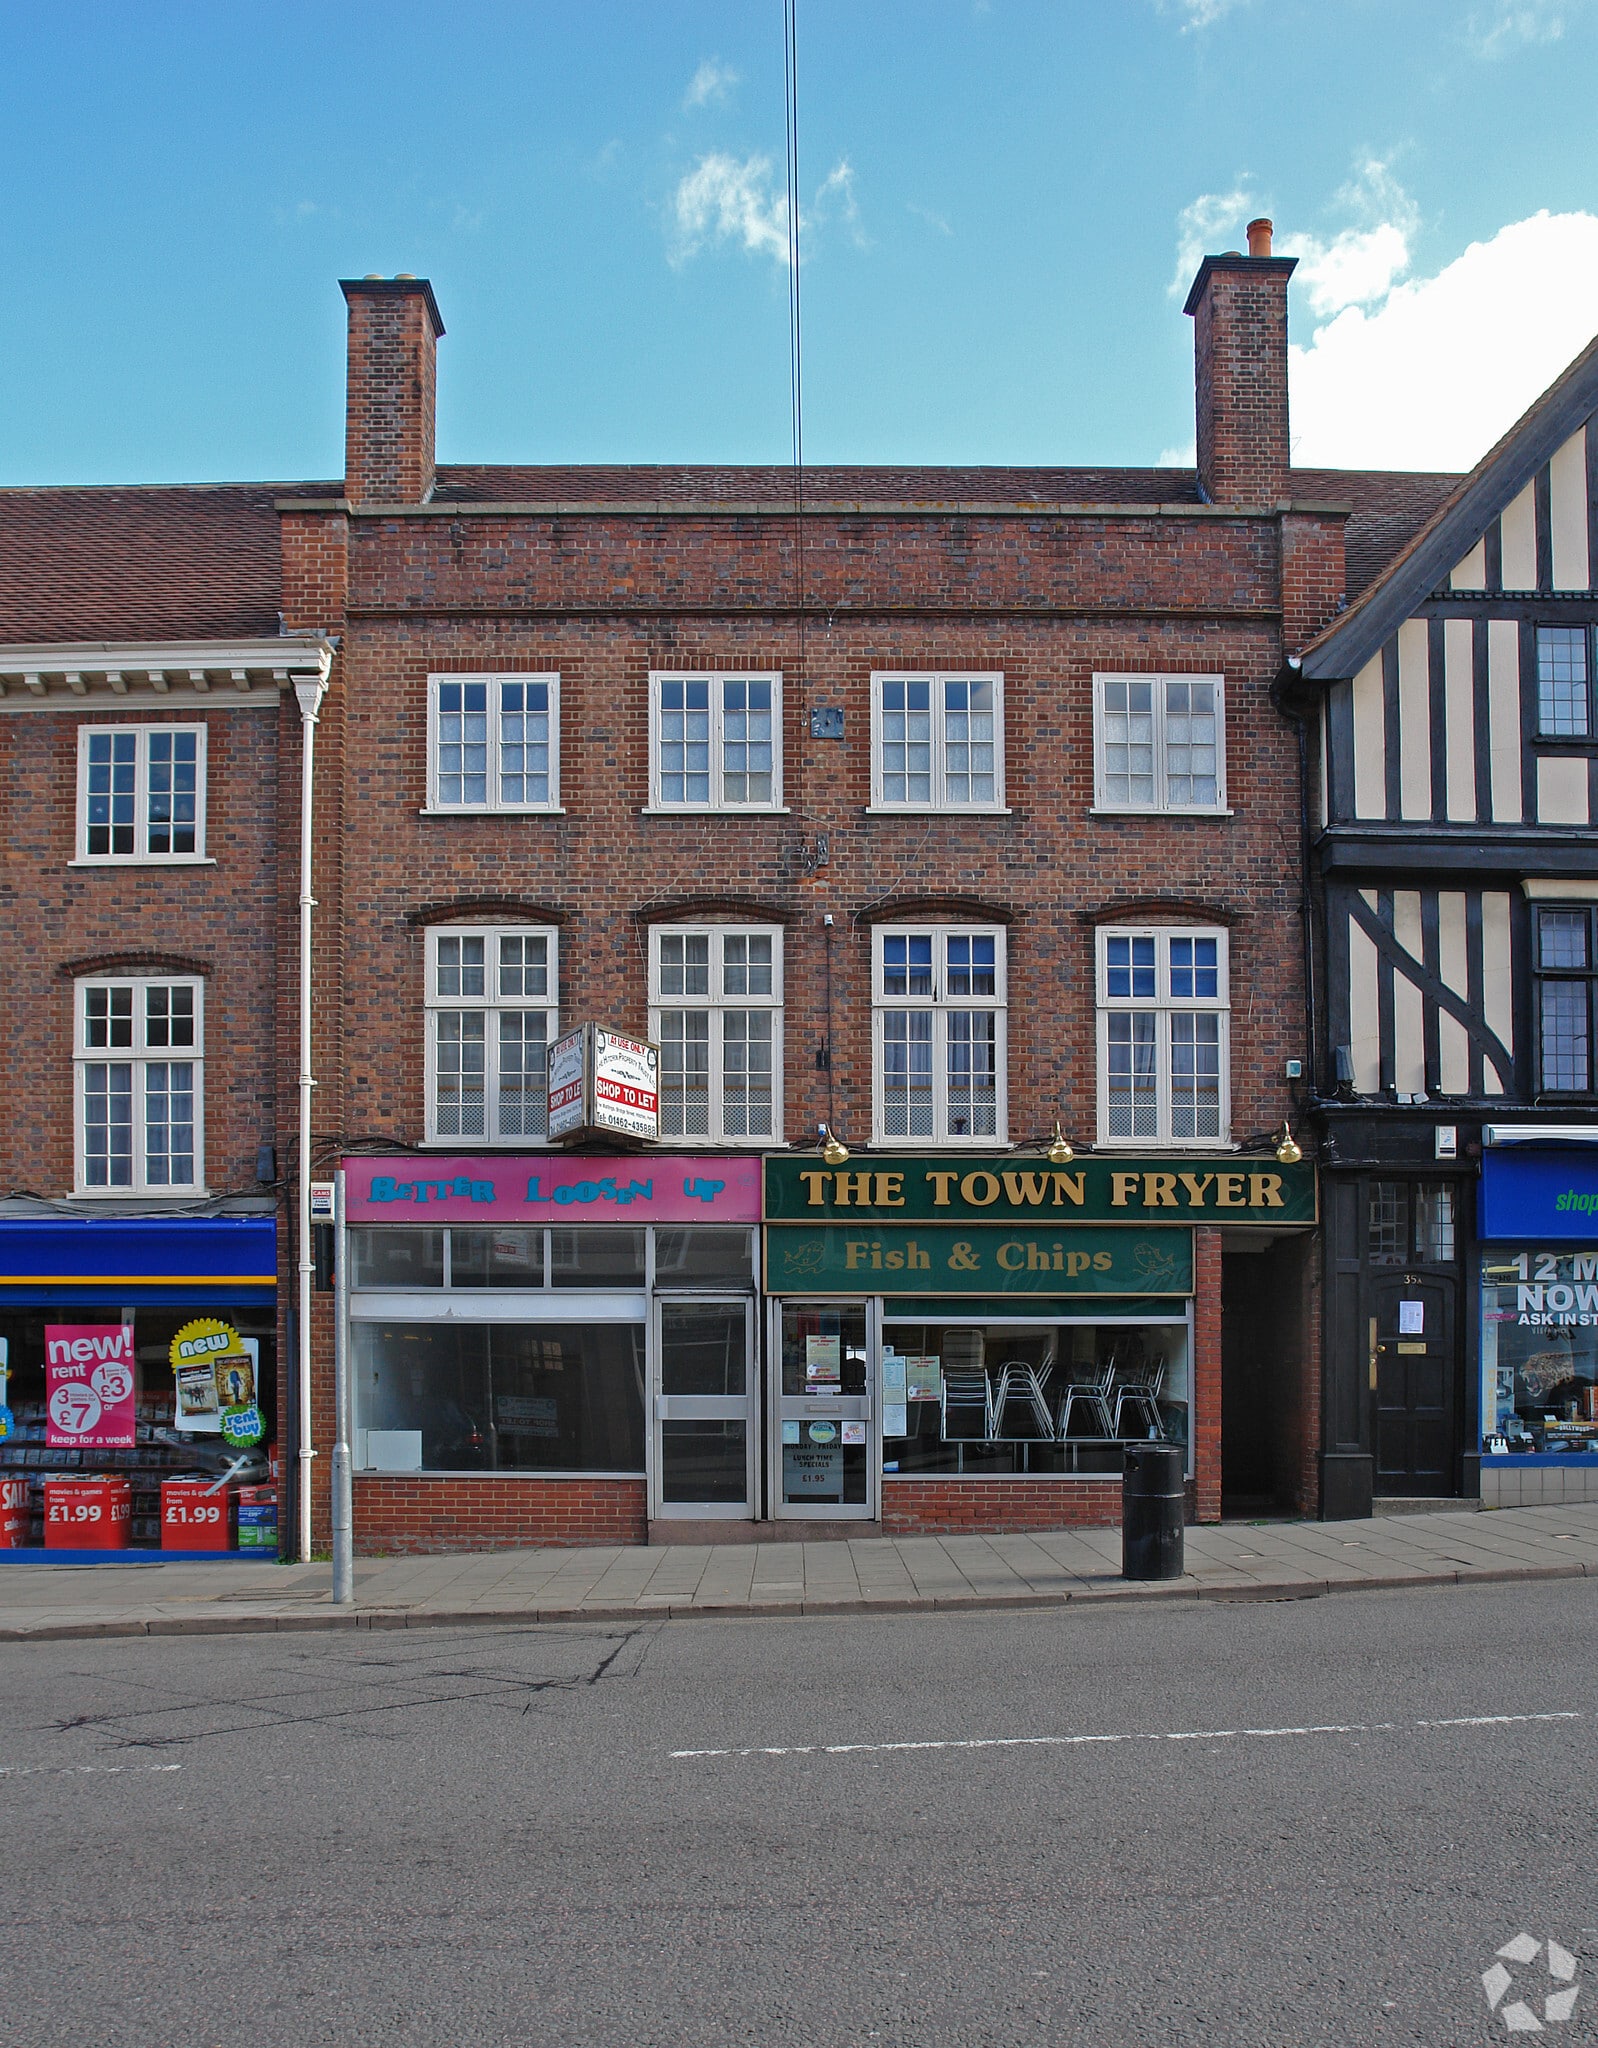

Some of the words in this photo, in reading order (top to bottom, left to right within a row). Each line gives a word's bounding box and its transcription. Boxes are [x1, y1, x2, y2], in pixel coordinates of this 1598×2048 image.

[618, 1038, 629, 1049] USE
[630, 1042, 646, 1055] ONLY
[550, 1092, 565, 1109] SHOP
[566, 1088, 573, 1101] TO
[597, 1079, 621, 1099] SHOP
[624, 1089, 636, 1104] TO
[638, 1092, 654, 1109] LET
[366, 1176, 497, 1205] BETTER
[524, 1176, 653, 1206] LOOSEN
[684, 1177, 726, 1203] UP
[800, 1171, 906, 1206] THE
[925, 1172, 1087, 1206] TOWN
[1110, 1172, 1285, 1207] FRYER
[1555, 1189, 1598, 1216] shop
[845, 1241, 931, 1270] Fish
[948, 1242, 982, 1271] &
[996, 1242, 1113, 1277] Chips
[1512, 1253, 1558, 1280] 12
[1517, 1284, 1598, 1312] NOW
[1518, 1313, 1554, 1326] ASK
[48, 1326, 132, 1364] new!
[180, 1333, 229, 1358] new
[52, 1363, 86, 1379] rent
[98, 1367, 106, 1380] 1
[58, 1389, 69, 1404] 3
[101, 1377, 125, 1398] £3
[60, 1404, 91, 1429] £7
[104, 1403, 115, 1411] or
[227, 1409, 258, 1424] rent
[51, 1435, 77, 1445] keep
[79, 1435, 94, 1444] for
[96, 1436, 103, 1444] a
[106, 1435, 132, 1444] week
[233, 1423, 260, 1436] buy
[2, 1482, 30, 1510] SALE
[81, 1489, 103, 1497] games
[49, 1506, 102, 1522] £1.99
[166, 1507, 220, 1523] £1.99
